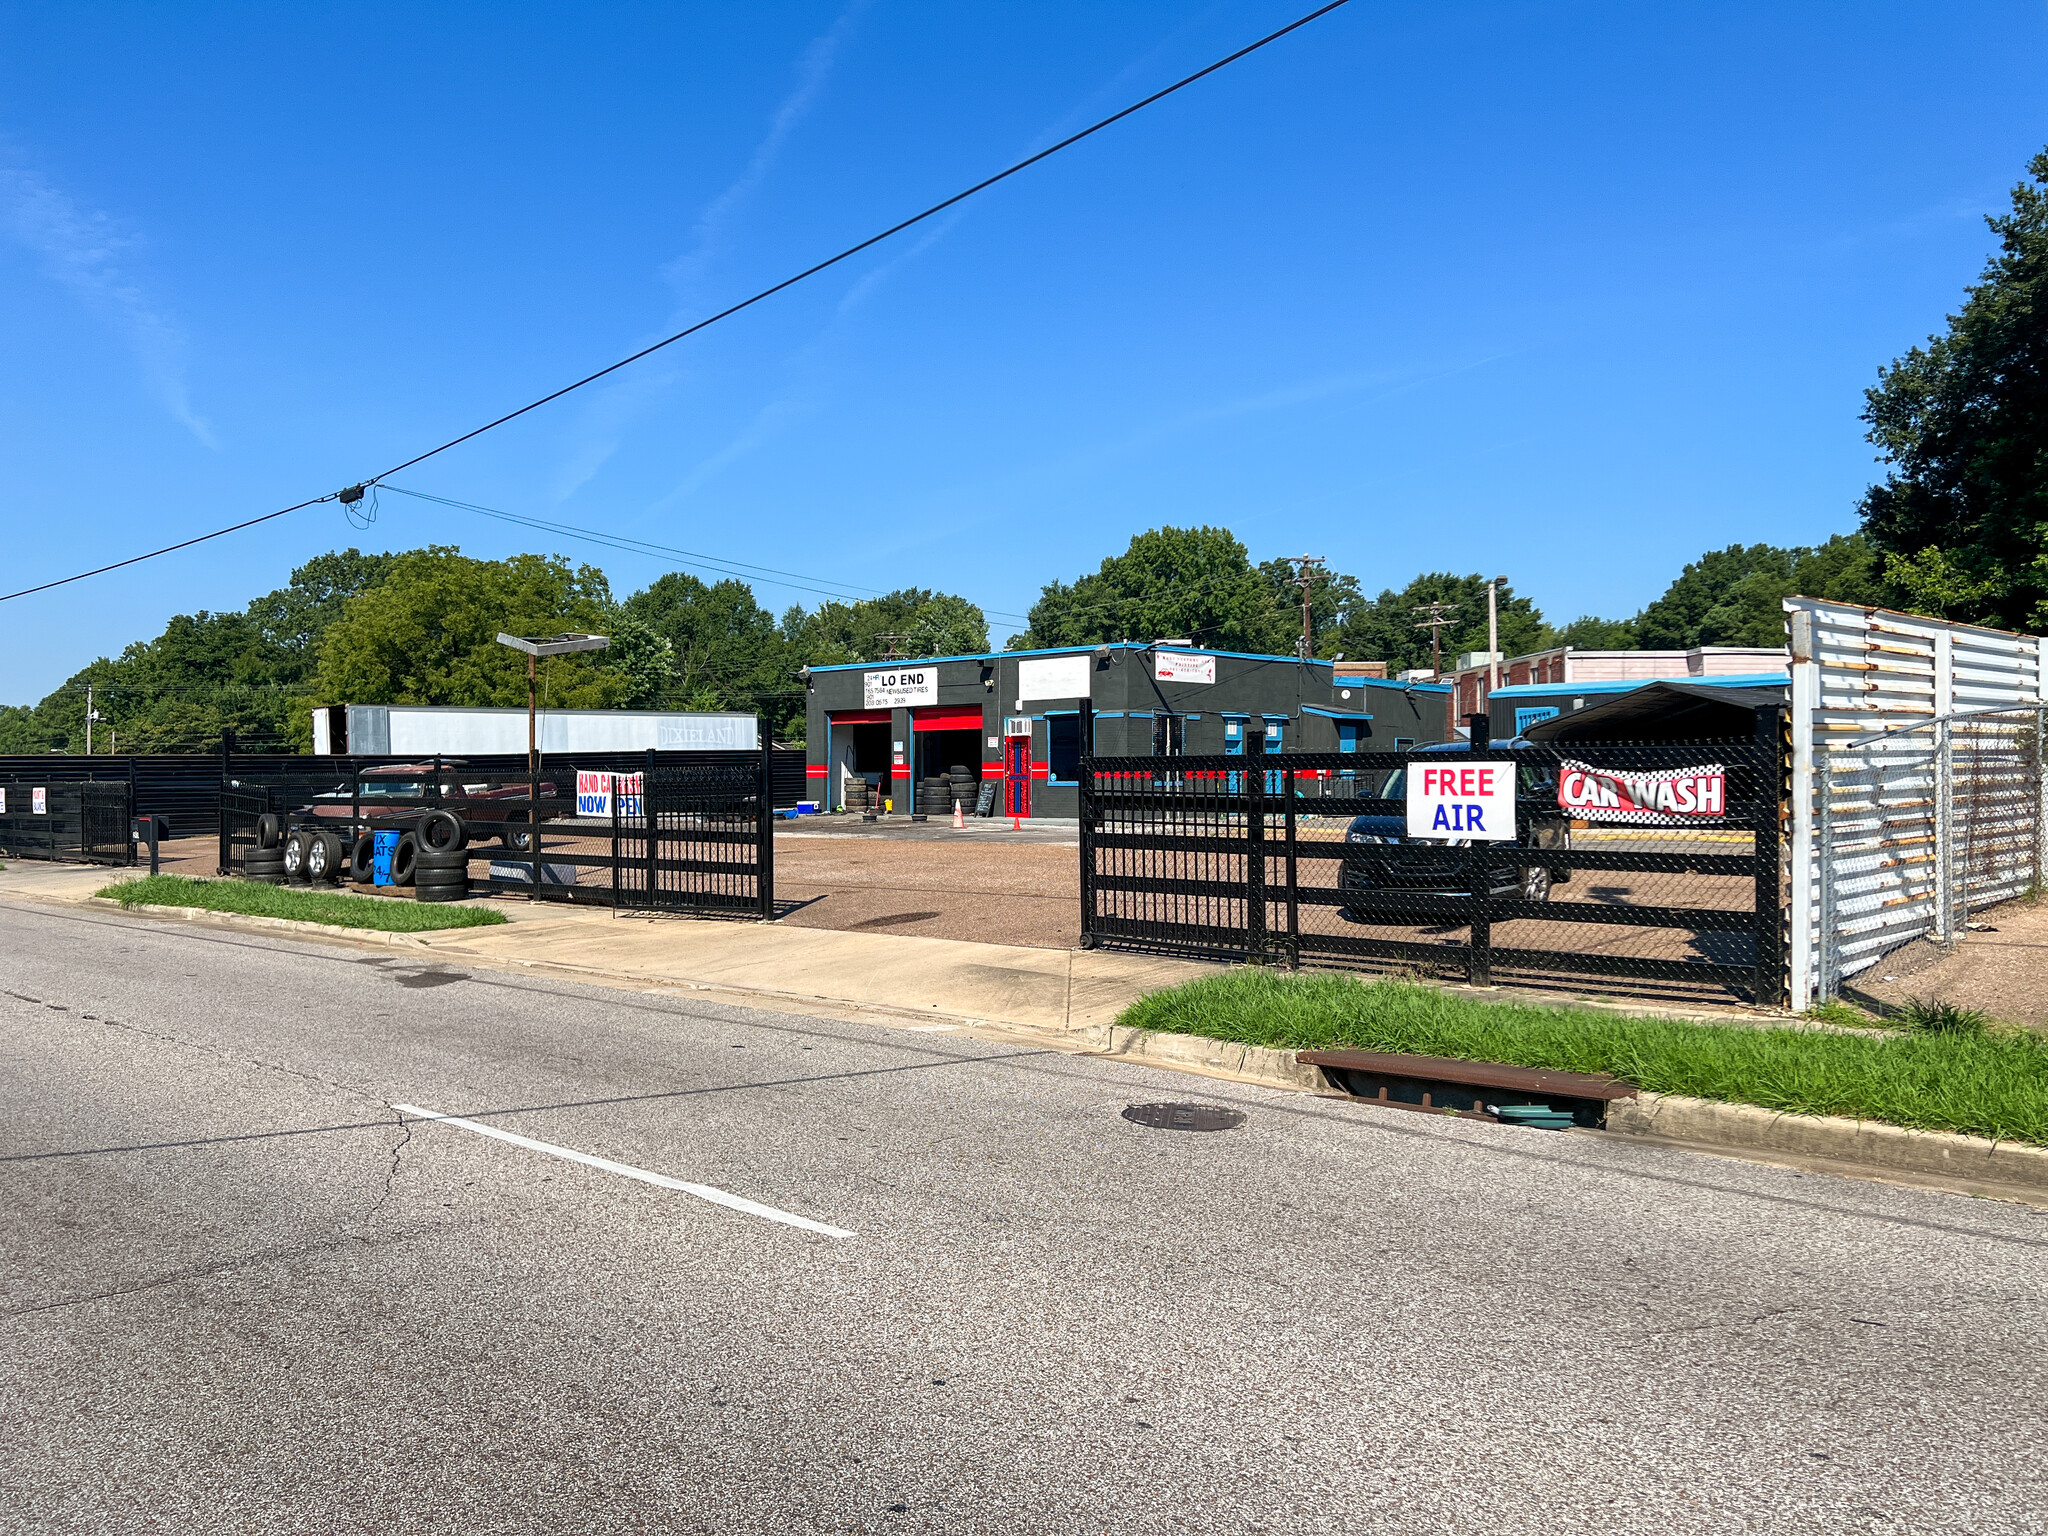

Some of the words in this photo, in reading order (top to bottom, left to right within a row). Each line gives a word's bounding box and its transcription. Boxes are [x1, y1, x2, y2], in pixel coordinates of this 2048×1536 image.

[882, 675, 896, 686] LO
[901, 673, 924, 685] END
[660, 726, 734, 745] DIXIELAND
[579, 774, 598, 793] HAND
[1424, 769, 1494, 796] FREE
[1563, 771, 1621, 808] CAR
[1623, 776, 1721, 813] WASH
[578, 795, 606, 813] NOW
[617, 797, 641, 815] PEN
[1432, 804, 1487, 831] AIR
[374, 834, 387, 845] IX
